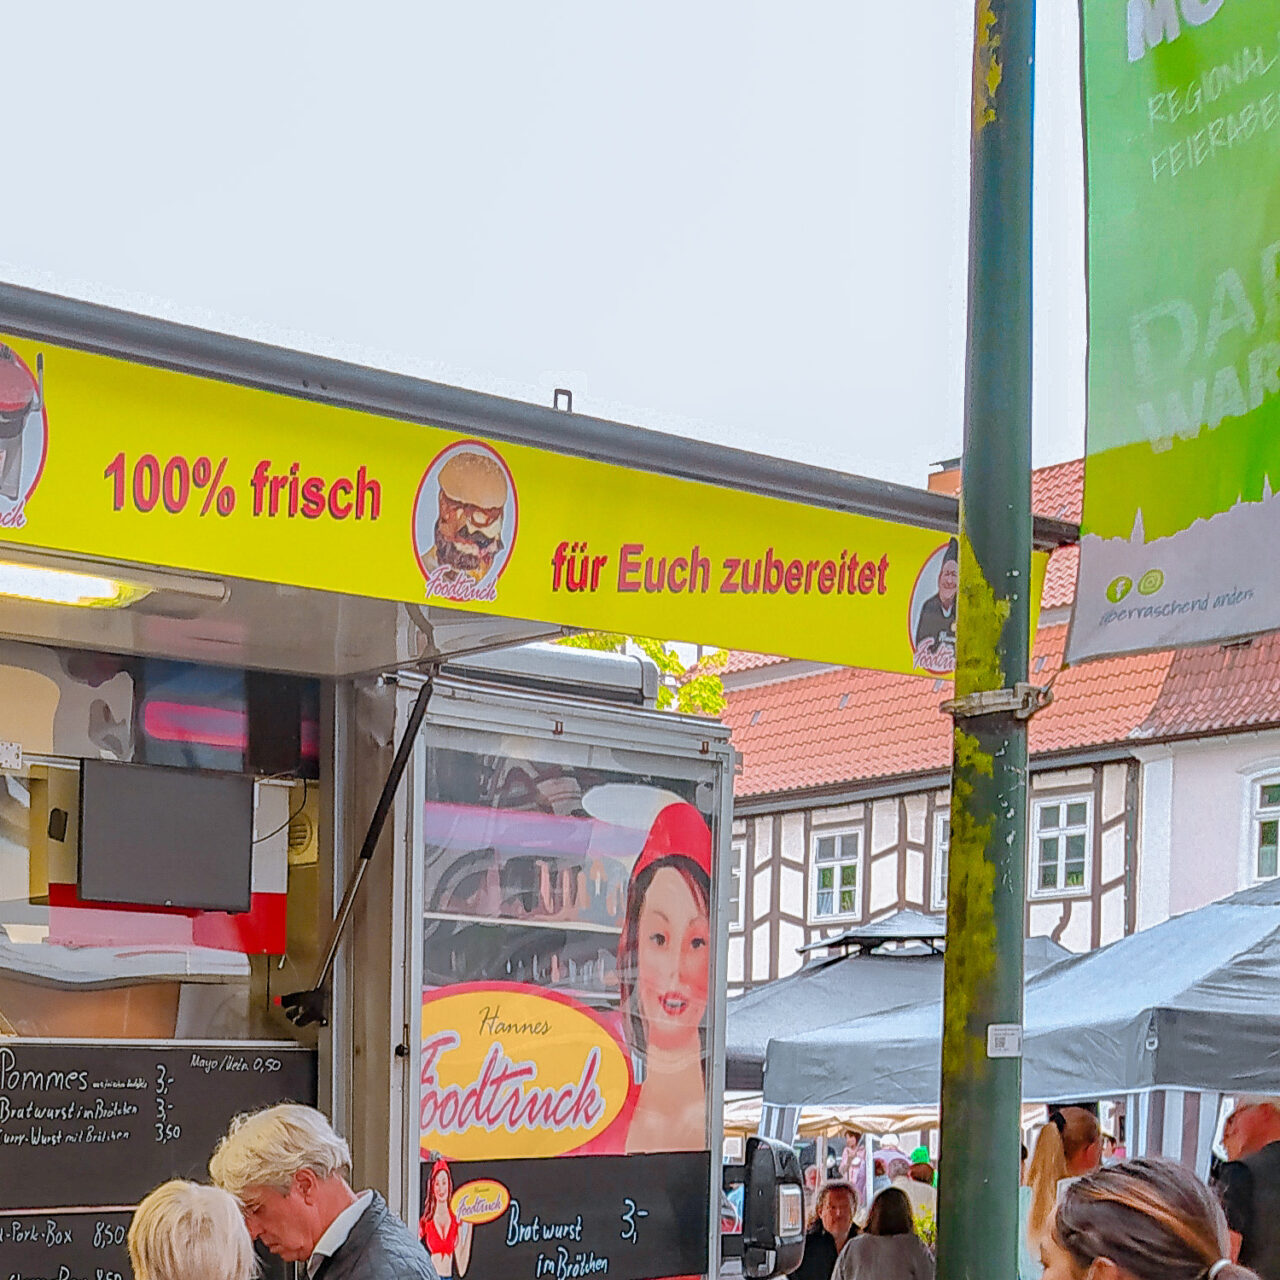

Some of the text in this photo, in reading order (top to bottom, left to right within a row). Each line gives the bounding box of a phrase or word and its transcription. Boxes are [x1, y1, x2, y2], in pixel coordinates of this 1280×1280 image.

[1151, 92, 1280, 182] FEIERABE
[102, 452, 383, 521] 100% frisch
[424, 564, 498, 603] Foodtruck
[551, 541, 890, 596] für Euch zubereitet
[478, 1006, 552, 1036] Hannes
[0, 1048, 88, 1091] Pommes
[155, 1065, 174, 1095] 3,-
[253, 1057, 282, 1073] 0,50
[420, 1033, 605, 1133] Foodtruck
[155, 1123, 181, 1144] 3,50
[456, 1193, 502, 1223] Foodtruck
[621, 1199, 649, 1244] 3,-
[93, 1221, 124, 1249] 8,50
[536, 1254, 556, 1278] im
